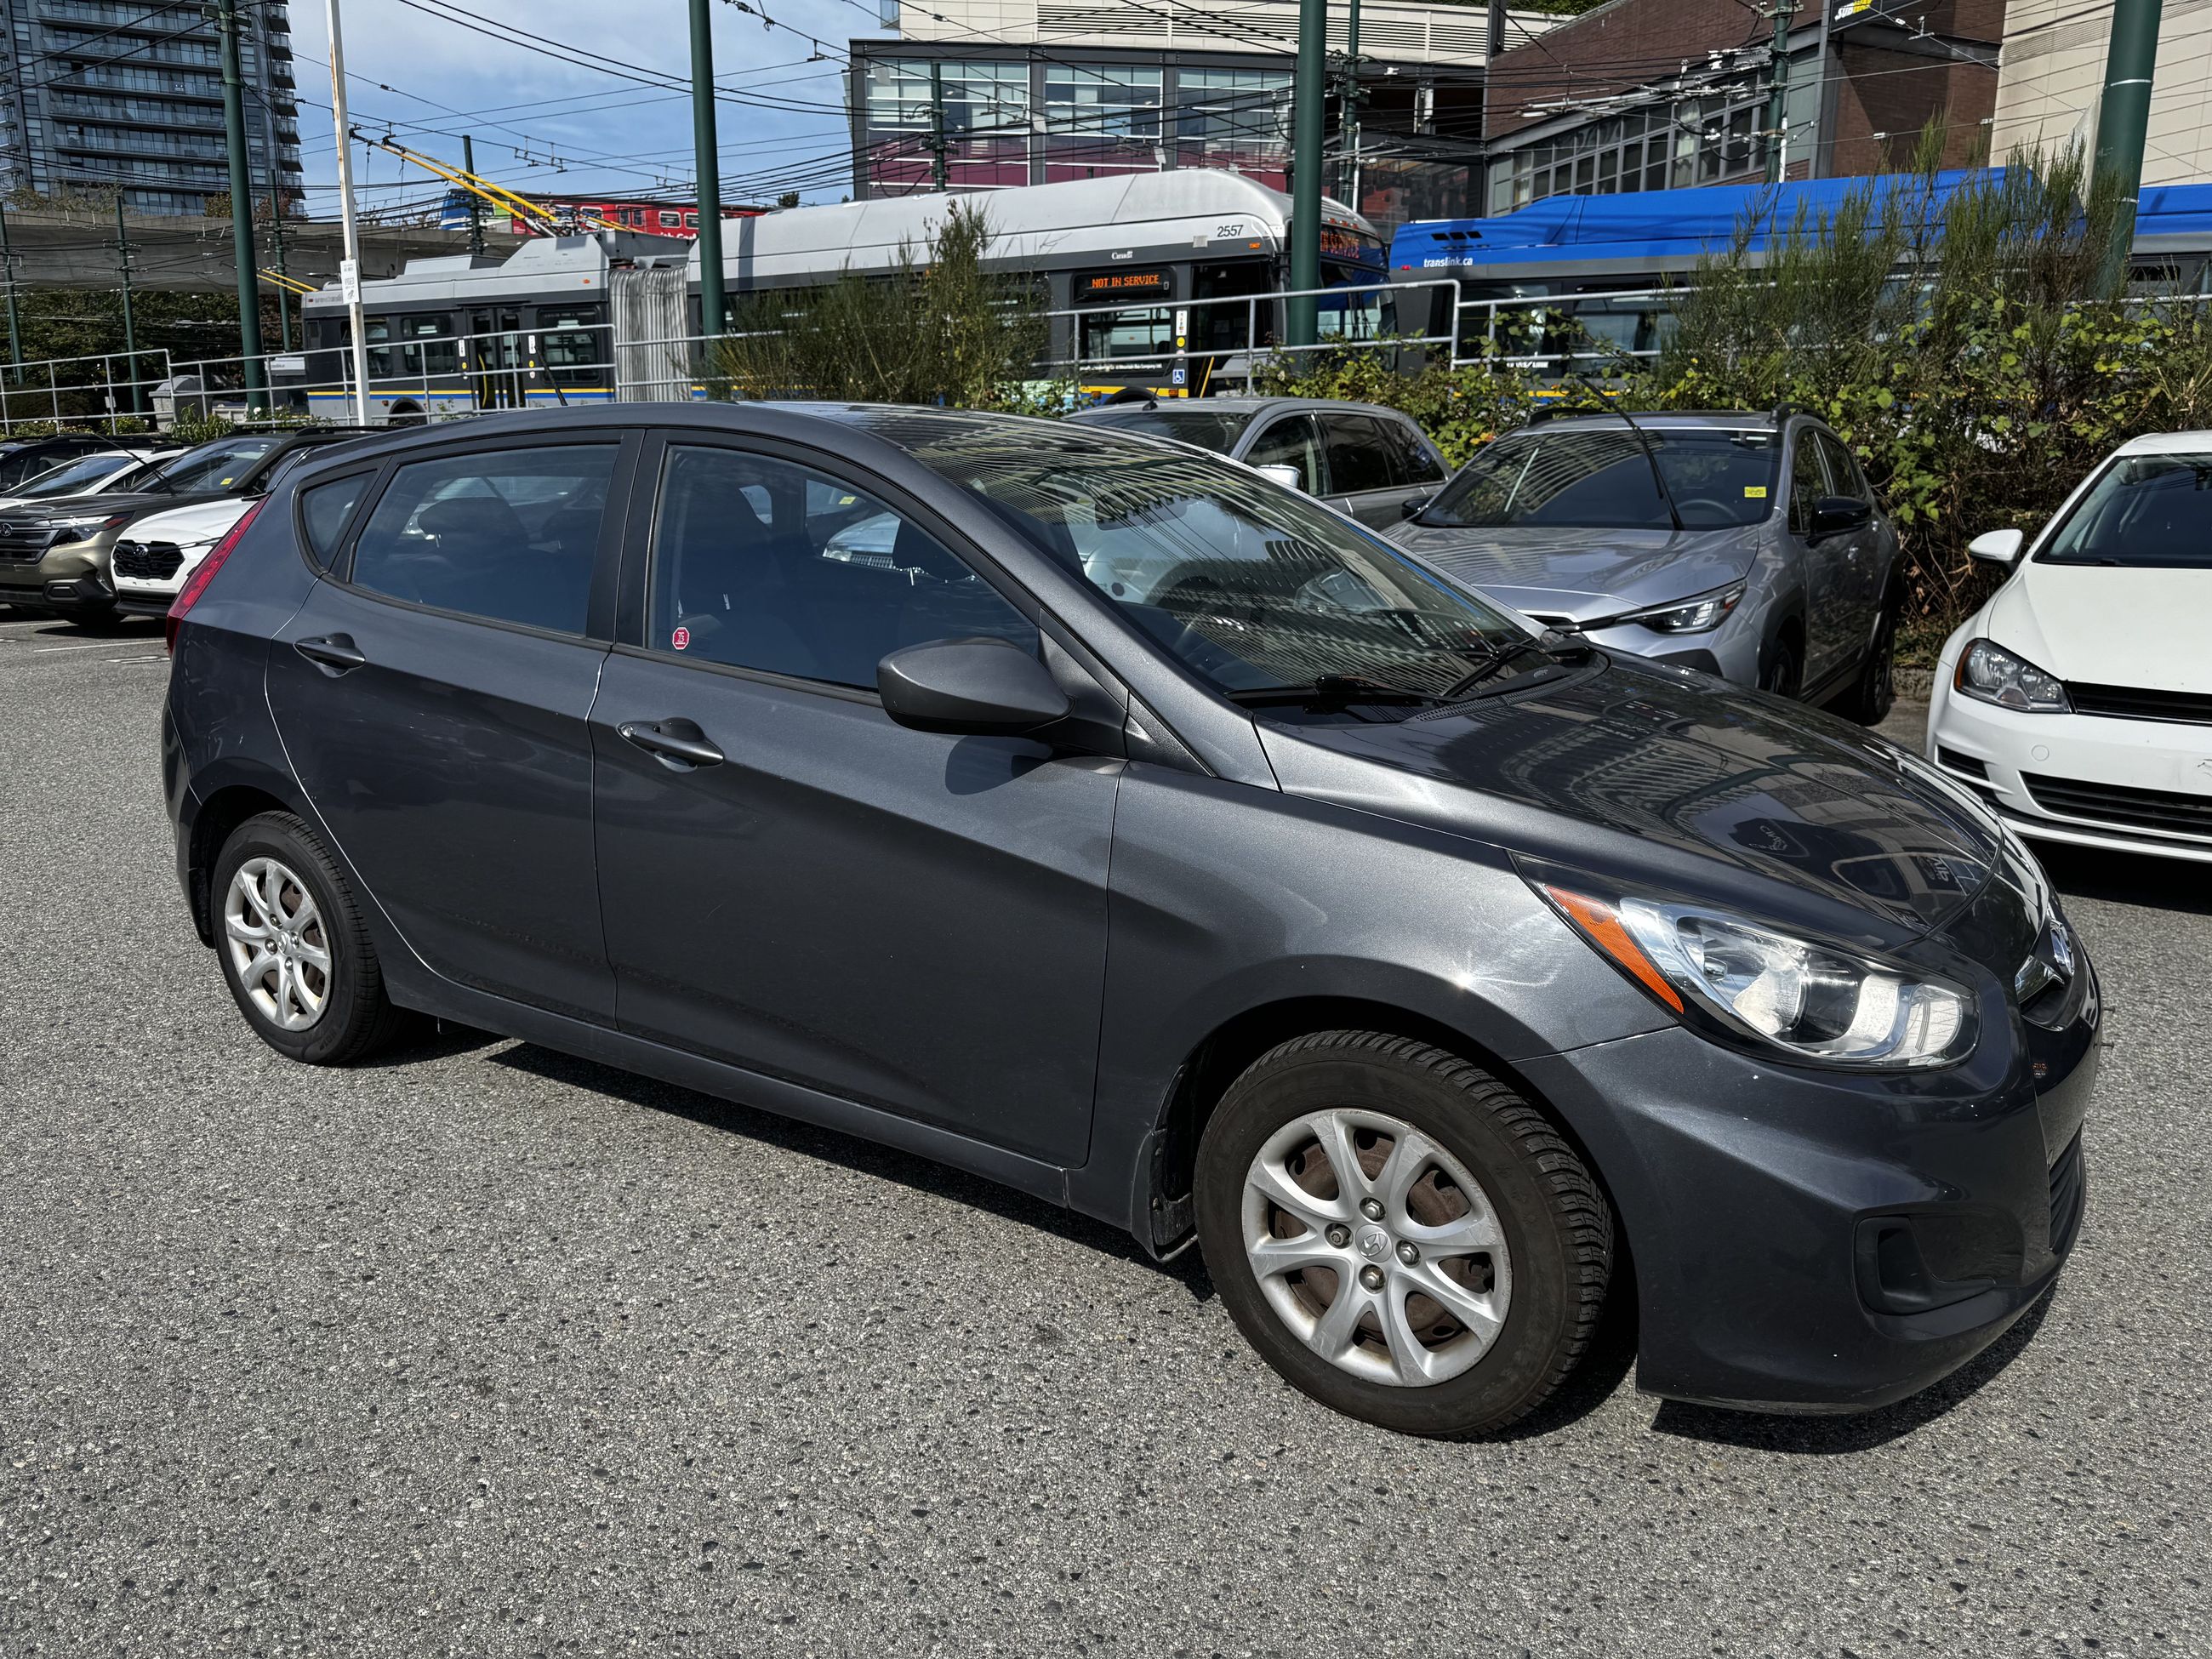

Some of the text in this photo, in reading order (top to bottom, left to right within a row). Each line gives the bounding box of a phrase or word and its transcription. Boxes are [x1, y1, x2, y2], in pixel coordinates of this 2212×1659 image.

[1217, 225, 1244, 237] 2557
[1330, 233, 1360, 259] SERVICE
[1423, 257, 1474, 268] translink.ca
[1092, 274, 1160, 288] NOT IN SERVICE
